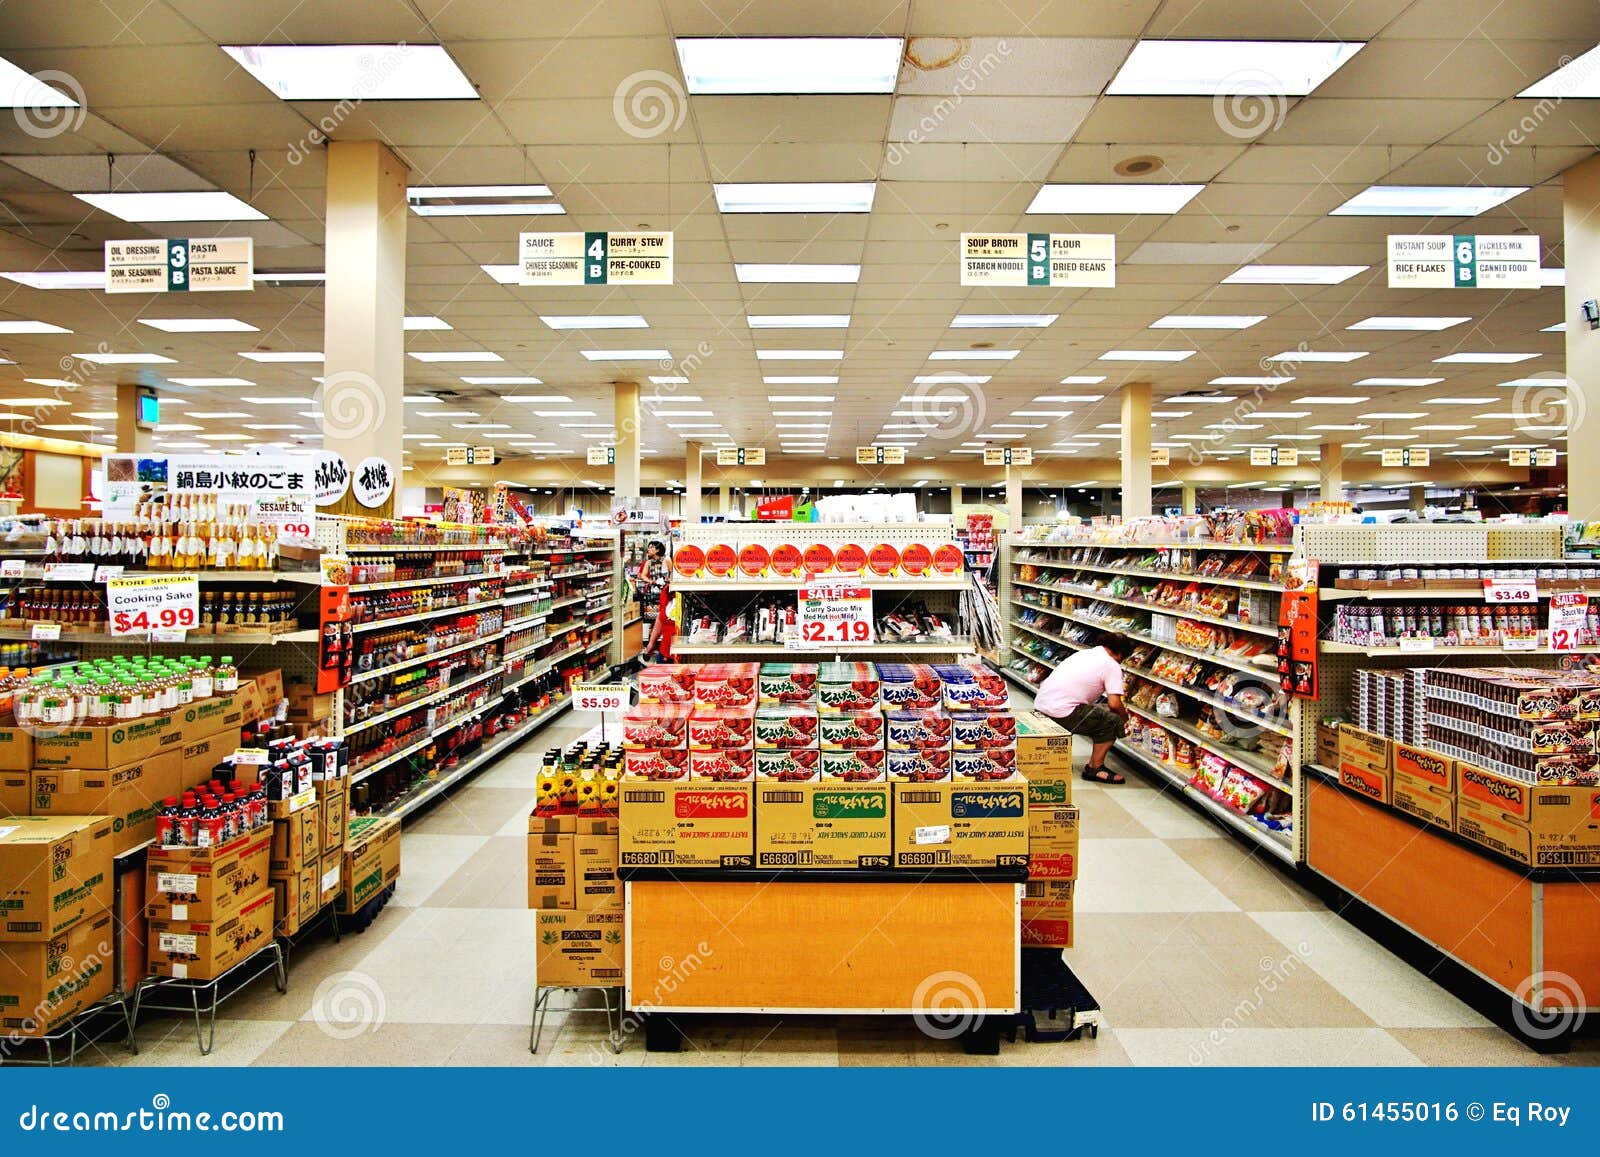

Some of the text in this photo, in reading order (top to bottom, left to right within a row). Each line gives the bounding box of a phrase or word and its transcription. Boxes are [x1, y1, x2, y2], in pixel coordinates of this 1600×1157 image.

[526, 239, 554, 248] SAUCE
[610, 238, 664, 246] CURRY STEW
[968, 239, 1018, 248] SOUP BROTH
[1053, 240, 1080, 248] FLOUR
[1396, 242, 1446, 250] INSTANT SOUP
[126, 246, 160, 254] DRESSING
[191, 244, 217, 252] PASTA
[588, 239, 604, 260] 4
[1031, 240, 1046, 262] 5
[1457, 242, 1472, 264] 6
[171, 245, 186, 267] 3
[191, 266, 236, 275] PASTA SAUCE
[526, 261, 578, 270] CHINESE SEASONING
[968, 262, 1024, 270] STARCH NOODLE
[1080, 263, 1106, 272] BEANS
[1416, 264, 1446, 272] FLAKES
[128, 268, 161, 276] SEASONING
[590, 265, 602, 277] B
[1033, 266, 1045, 278] B
[1460, 268, 1472, 280] B
[172, 271, 184, 284] B
[177, 471, 304, 489] 鍋島小紋のごま
[260, 504, 304, 512] SESAME OIL
[112, 576, 194, 587] STORE SPECIAL
[115, 592, 192, 604] Cooking Sake
[1496, 590, 1530, 600] $3.49
[114, 608, 194, 632] $4.99
[803, 622, 870, 641] $2.19
[582, 698, 620, 708] $5.99
[624, 853, 656, 864] 08994
[724, 857, 751, 866] S&B
[762, 853, 795, 863] 08995
[861, 857, 888, 866] S&B
[900, 853, 933, 864] 08996
[1000, 856, 1027, 865] S&B
